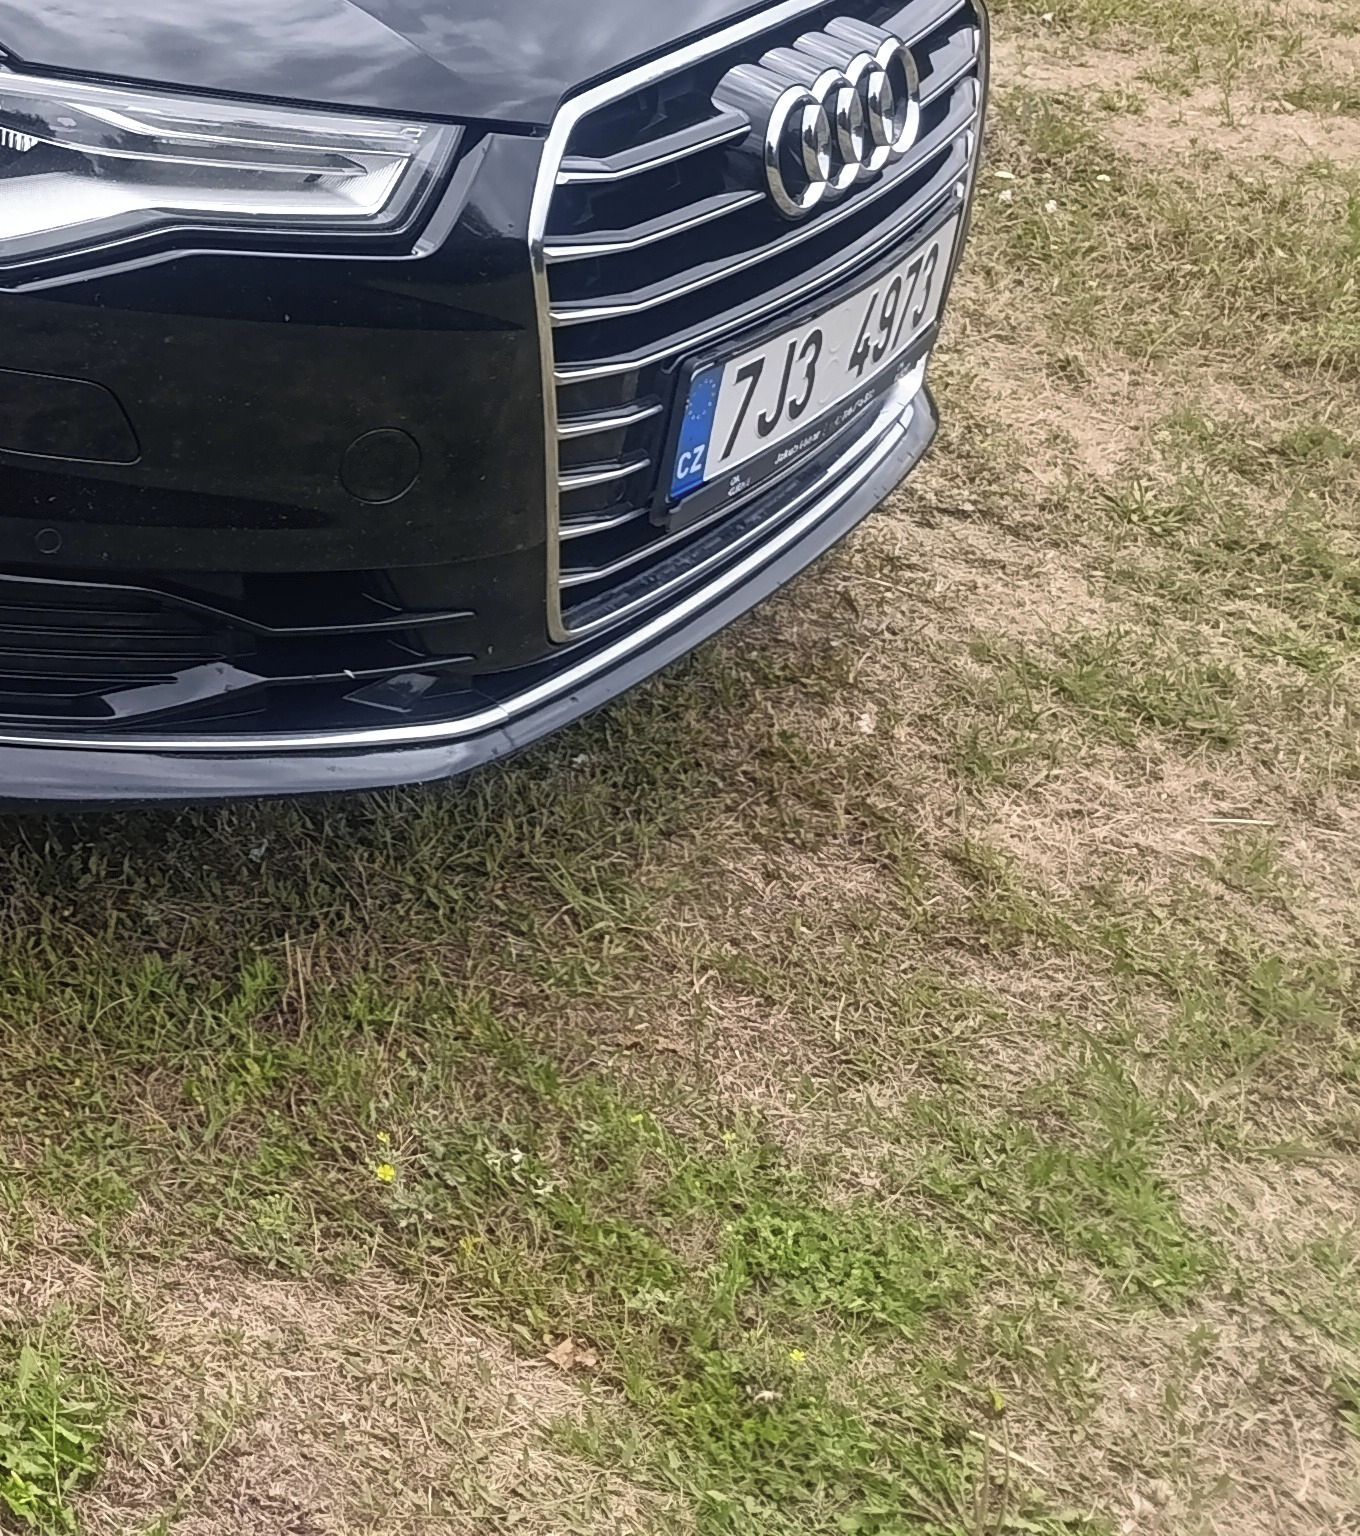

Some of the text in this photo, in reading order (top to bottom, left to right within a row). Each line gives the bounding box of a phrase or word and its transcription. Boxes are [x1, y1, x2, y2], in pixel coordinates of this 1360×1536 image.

[719, 242, 940, 461] 7J3 4973
[676, 444, 706, 480] CZ
